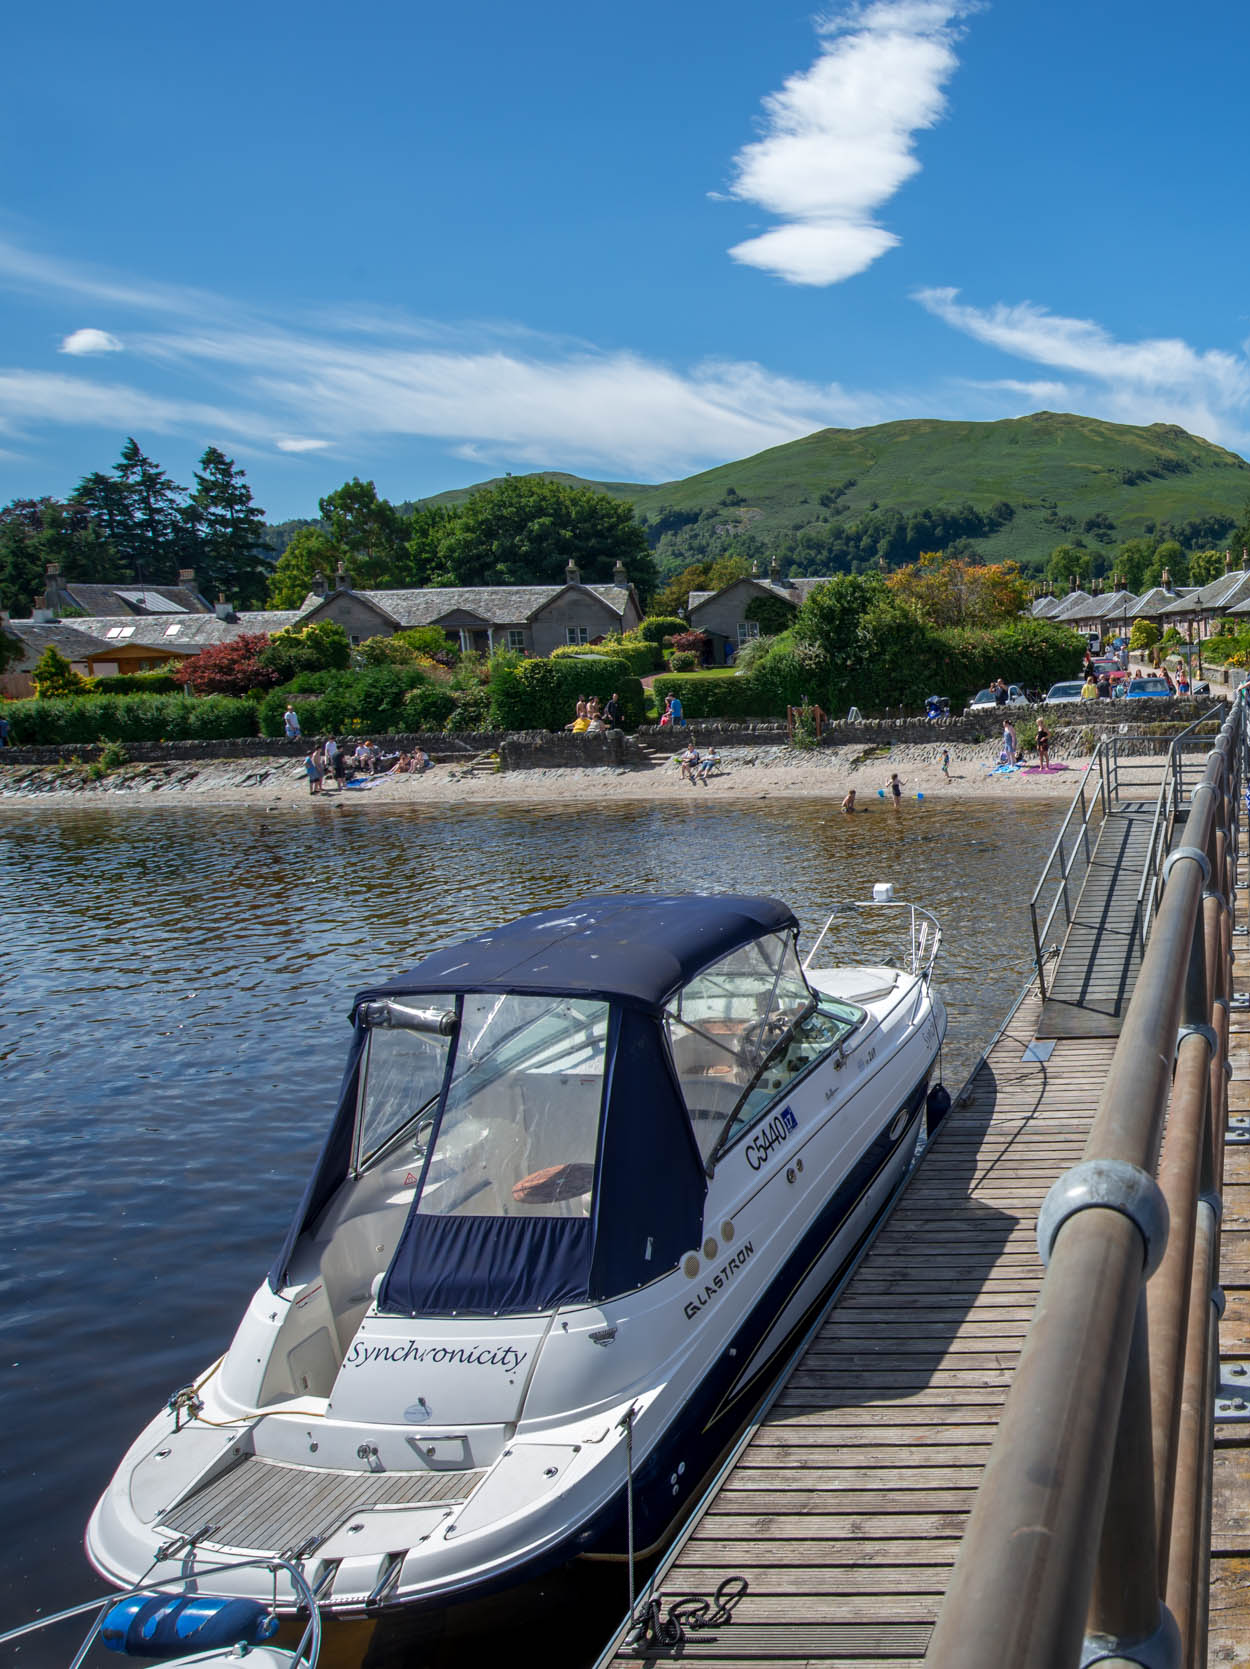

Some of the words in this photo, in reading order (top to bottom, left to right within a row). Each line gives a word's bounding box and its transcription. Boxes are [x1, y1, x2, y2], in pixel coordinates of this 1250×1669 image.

[745, 1116, 787, 1171] C5440
[683, 1240, 755, 1320] GLASTRON
[347, 1339, 528, 1373] Synchronicity
